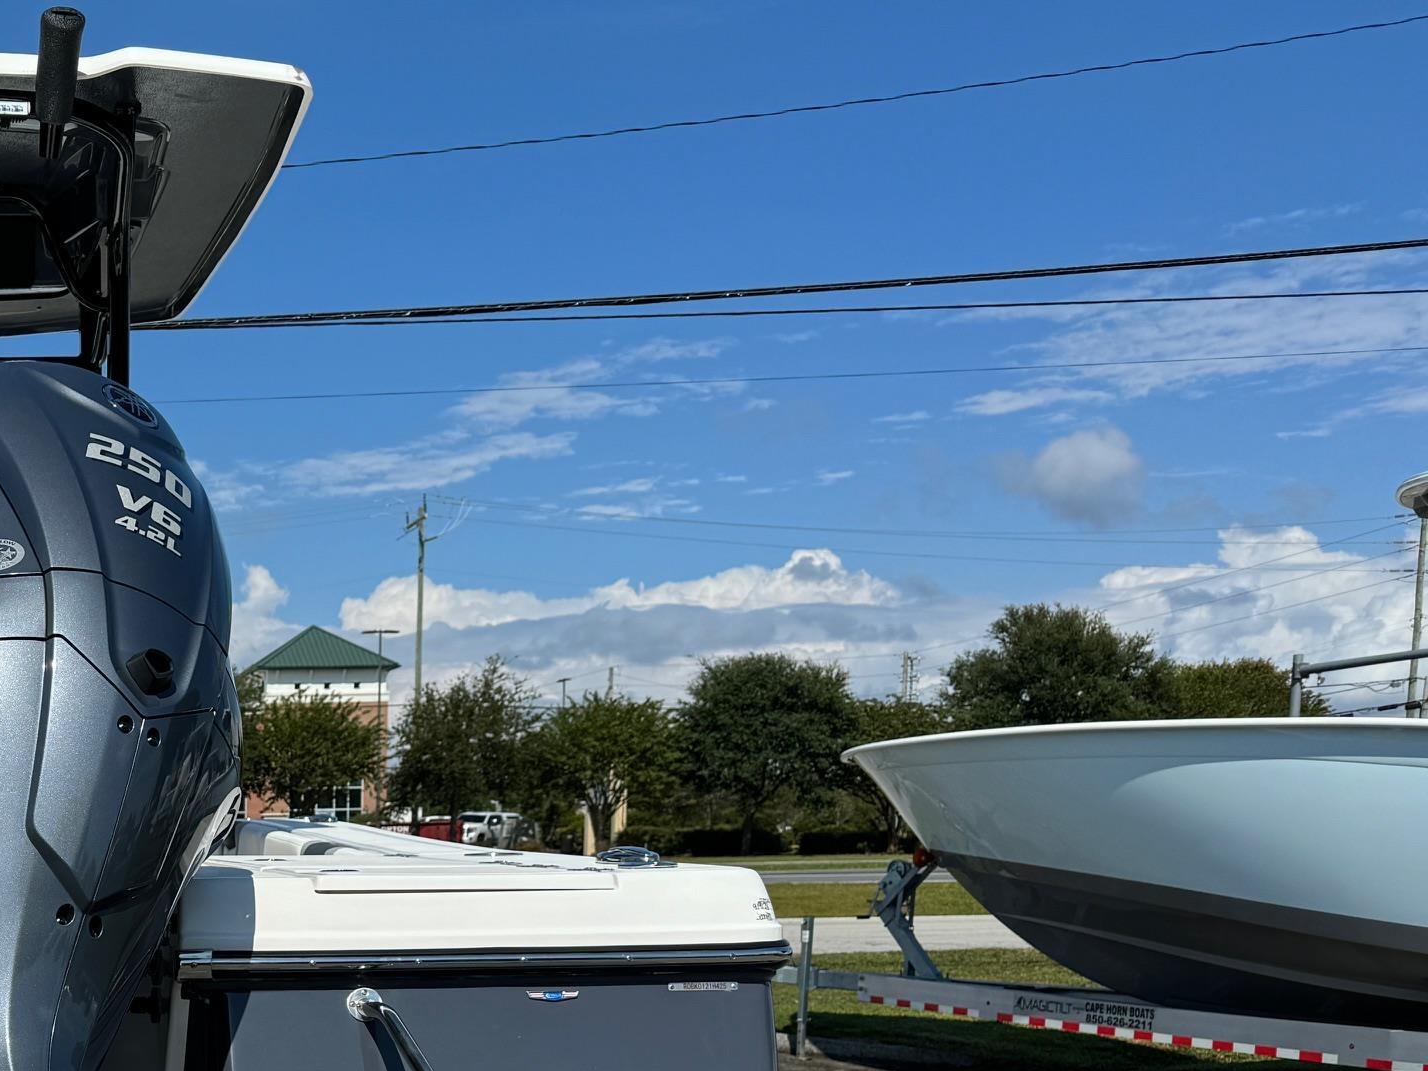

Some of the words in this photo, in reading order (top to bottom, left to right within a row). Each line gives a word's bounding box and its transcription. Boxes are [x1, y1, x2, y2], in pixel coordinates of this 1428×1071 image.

[86, 432, 192, 509] 250
[116, 484, 182, 536] V6
[114, 515, 182, 556] 4.2L
[1085, 1002, 1104, 1014] CAPE
[1106, 1004, 1128, 1017] HORN
[1129, 1007, 1155, 1020] BOATS
[1085, 1013, 1153, 1031] 850-626-2211
